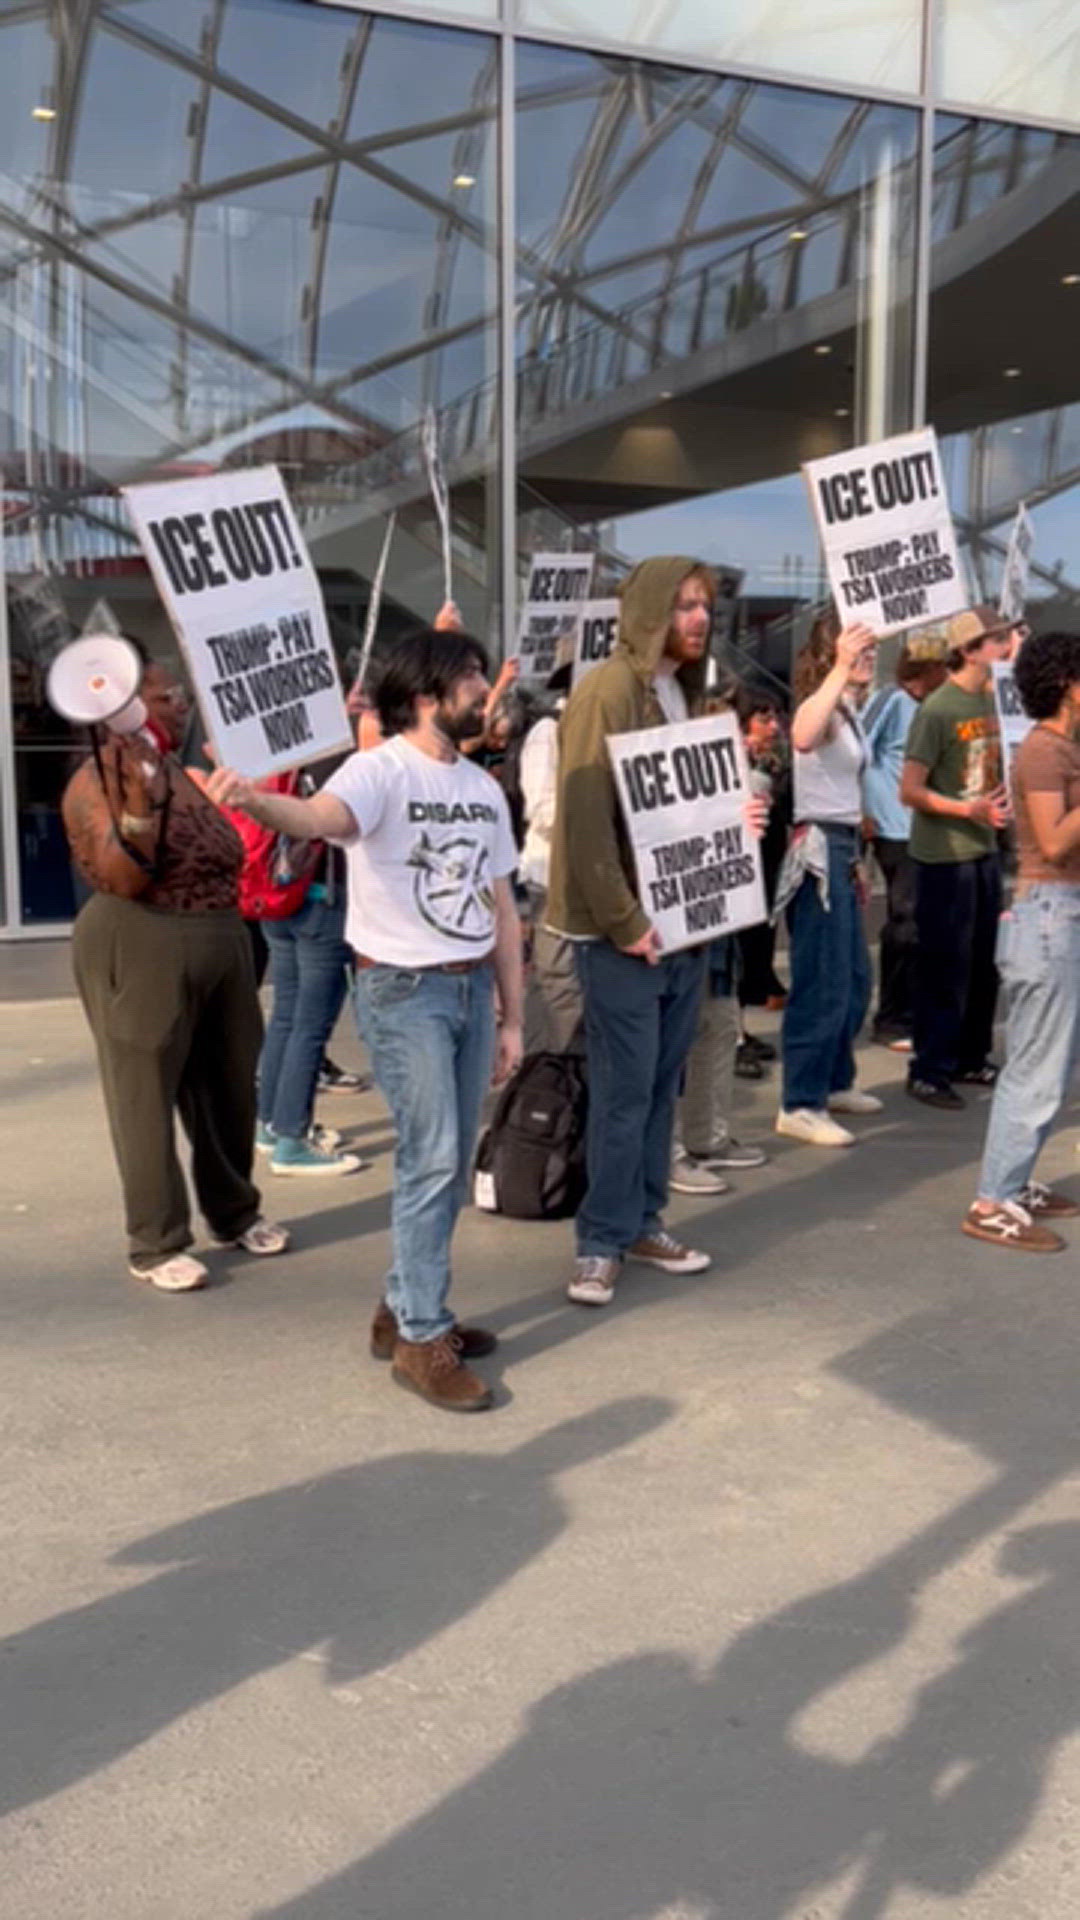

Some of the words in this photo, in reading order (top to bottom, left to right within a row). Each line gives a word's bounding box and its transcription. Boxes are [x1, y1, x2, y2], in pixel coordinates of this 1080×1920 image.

[819, 469, 873, 524] ICE
[871, 451, 939, 511] OUT!
[147, 512, 228, 595] ICE
[210, 498, 302, 582] OUT!
[843, 539, 912, 578] TRUMP:
[910, 530, 941, 561] PAY
[840, 574, 877, 608] TSA
[875, 554, 955, 597] WORKERS
[880, 588, 930, 625] NOW!
[205, 622, 284, 679] TRUMP:
[276, 609, 317, 656] PAY
[580, 618, 617, 661] ICE
[210, 675, 256, 726] TSA
[247, 649, 335, 709] WORKERS
[259, 701, 315, 756] NOW!
[621, 750, 676, 813] ICE
[672, 737, 742, 802] OUT!
[651, 836, 715, 878] TRUMP:
[712, 825, 744, 862] PAY
[648, 874, 681, 913] TSA
[680, 854, 756, 902] WORKERS
[684, 894, 730, 935] NOW!
